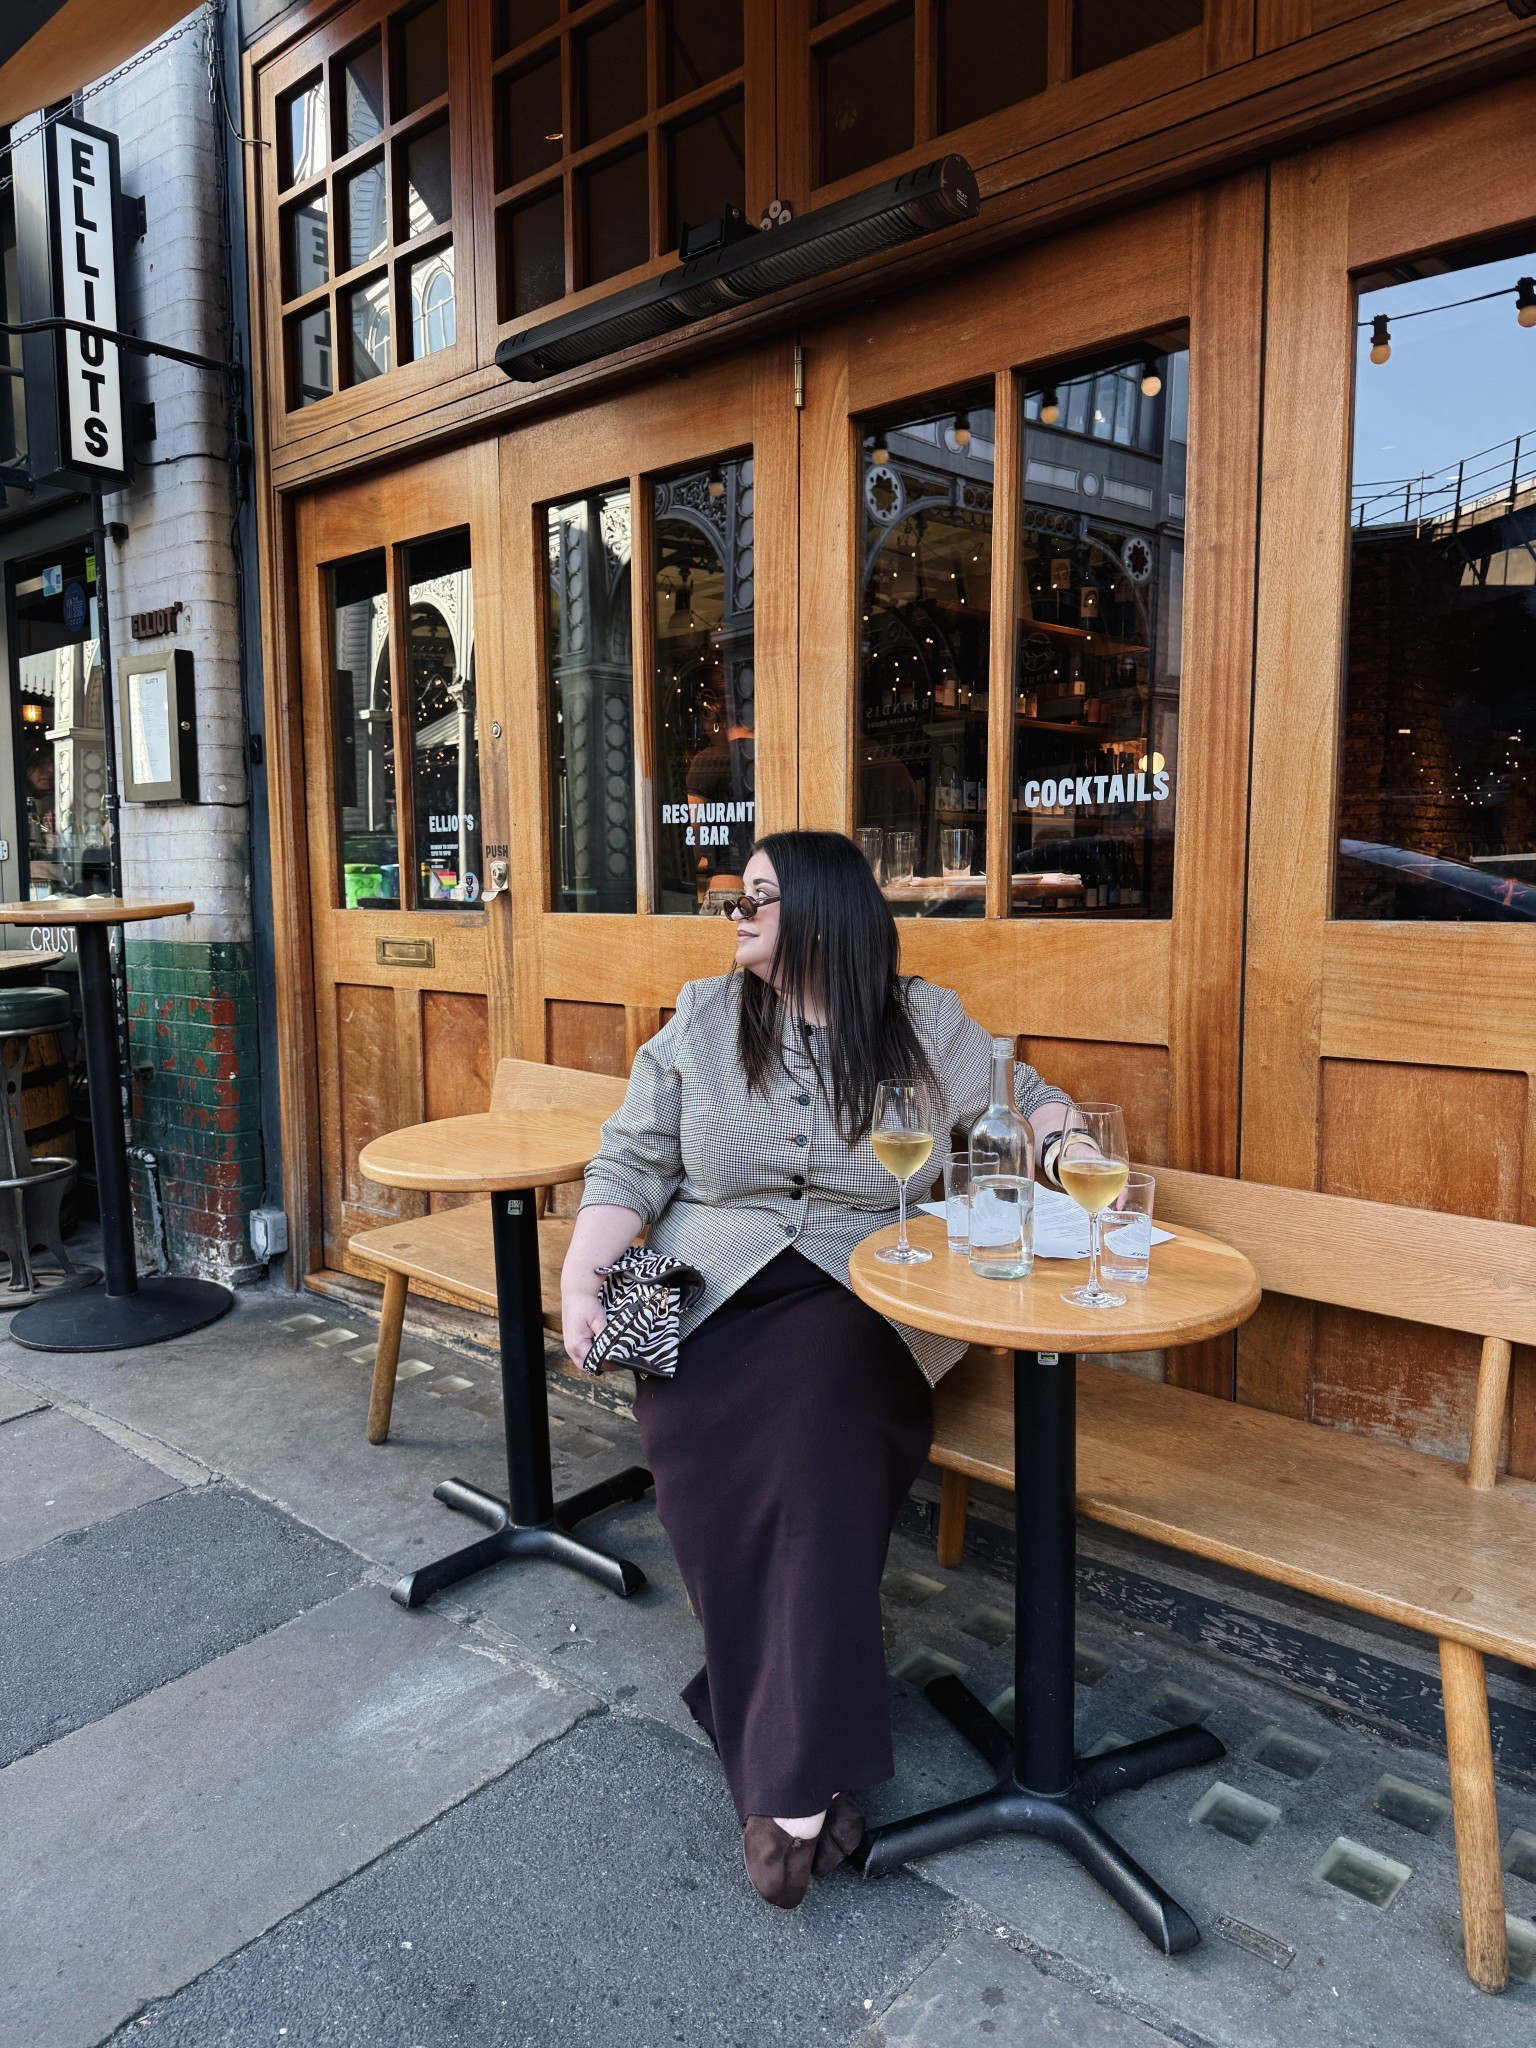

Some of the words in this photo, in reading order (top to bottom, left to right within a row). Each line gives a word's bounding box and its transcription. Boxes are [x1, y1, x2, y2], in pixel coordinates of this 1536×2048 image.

[71, 138, 109, 457] ELLIOTS
[1024, 771, 1170, 808] COCKTAILS
[662, 801, 755, 824] RESTAURANT
[685, 826, 696, 845] &
[699, 825, 730, 845] BAR
[485, 844, 509, 858] PUSH
